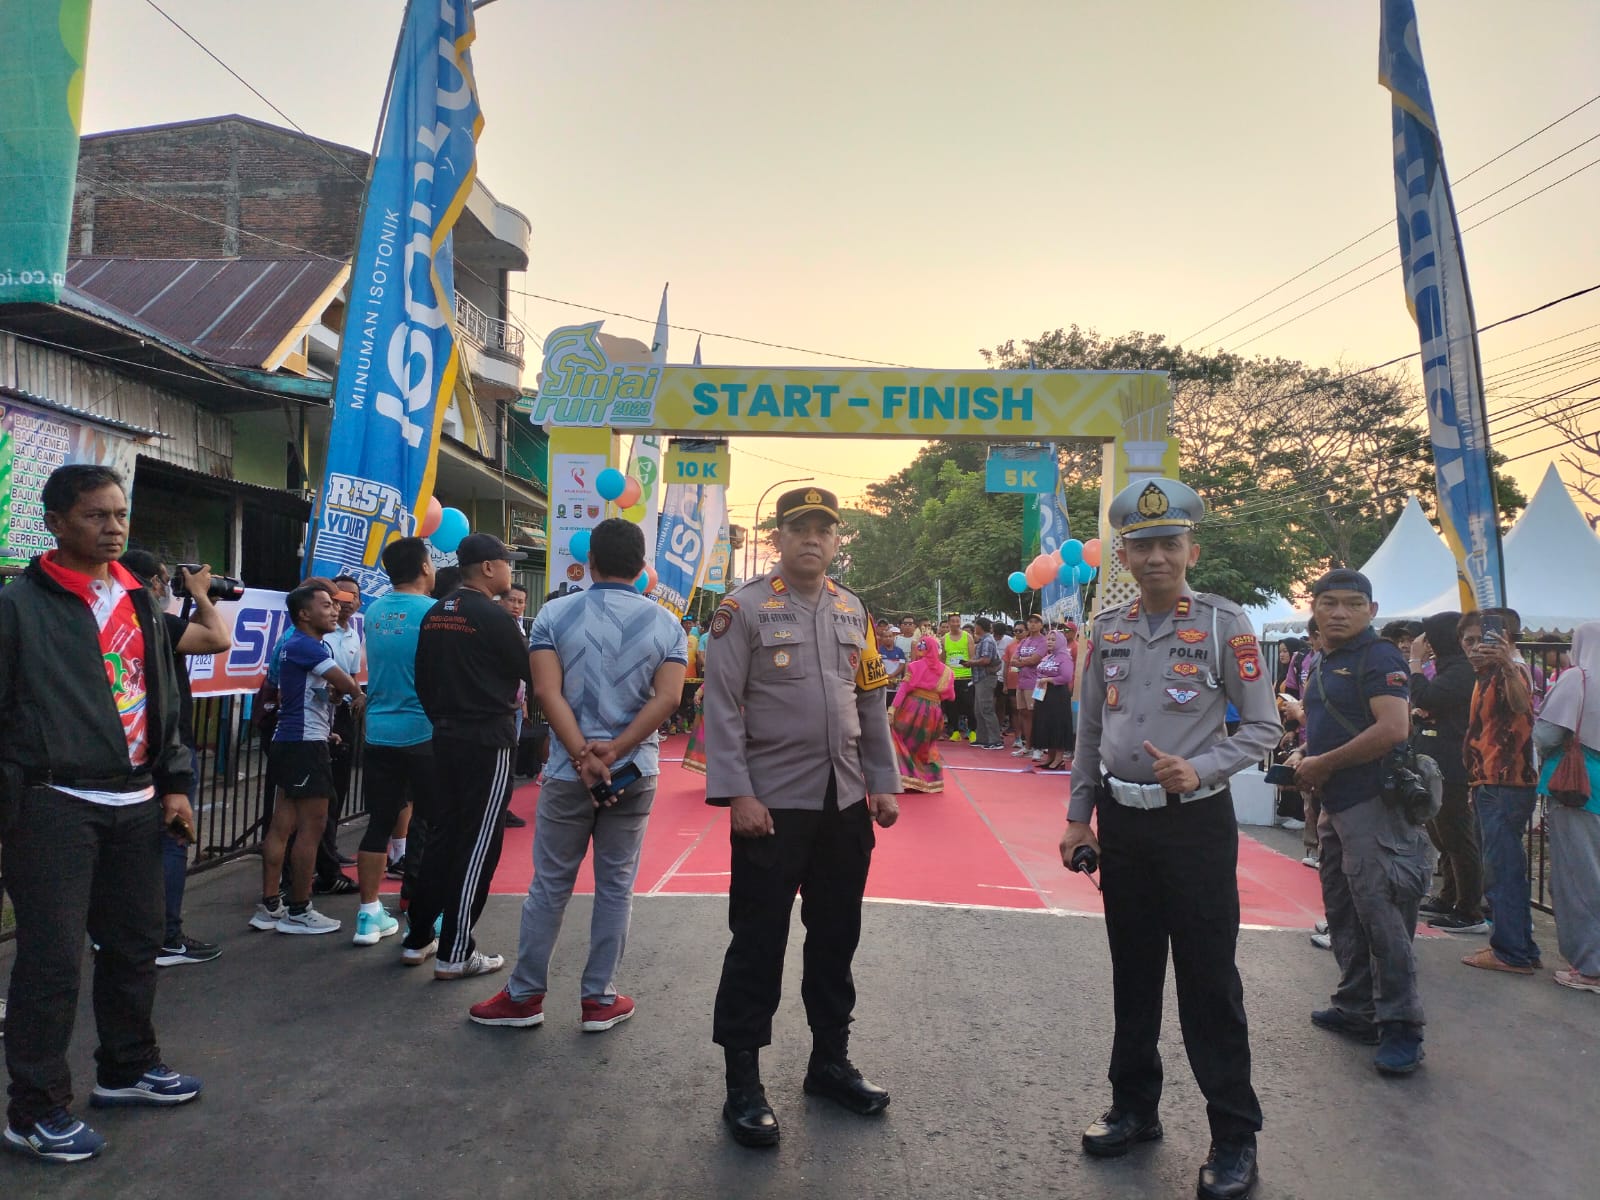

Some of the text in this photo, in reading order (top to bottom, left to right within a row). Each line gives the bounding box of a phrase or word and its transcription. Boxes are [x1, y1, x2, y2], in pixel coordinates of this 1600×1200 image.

[351, 208, 400, 409] MINUMAN ISOTONIK
[543, 360, 661, 402] Sinjai
[534, 397, 651, 422] run 2023
[692, 382, 840, 418] START
[882, 386, 1033, 421] FINISH
[15, 415, 69, 437] BAJU WANITA
[14, 429, 70, 451] BAJU KEMEJA
[15, 444, 64, 465] BAJU GAMIS
[13, 459, 33, 473] BAJU
[677, 461, 718, 478] 10 K
[13, 474, 33, 487] BAJU
[1004, 469, 1038, 487] 5 K
[12, 488, 32, 501] BAJU
[11, 503, 45, 517] CELANA
[10, 517, 31, 530] BAJU
[328, 511, 366, 539] YOUR
[8, 532, 41, 547] SEPREY
[195, 655, 212, 665] 2023
[1169, 648, 1208, 660] POLRI
